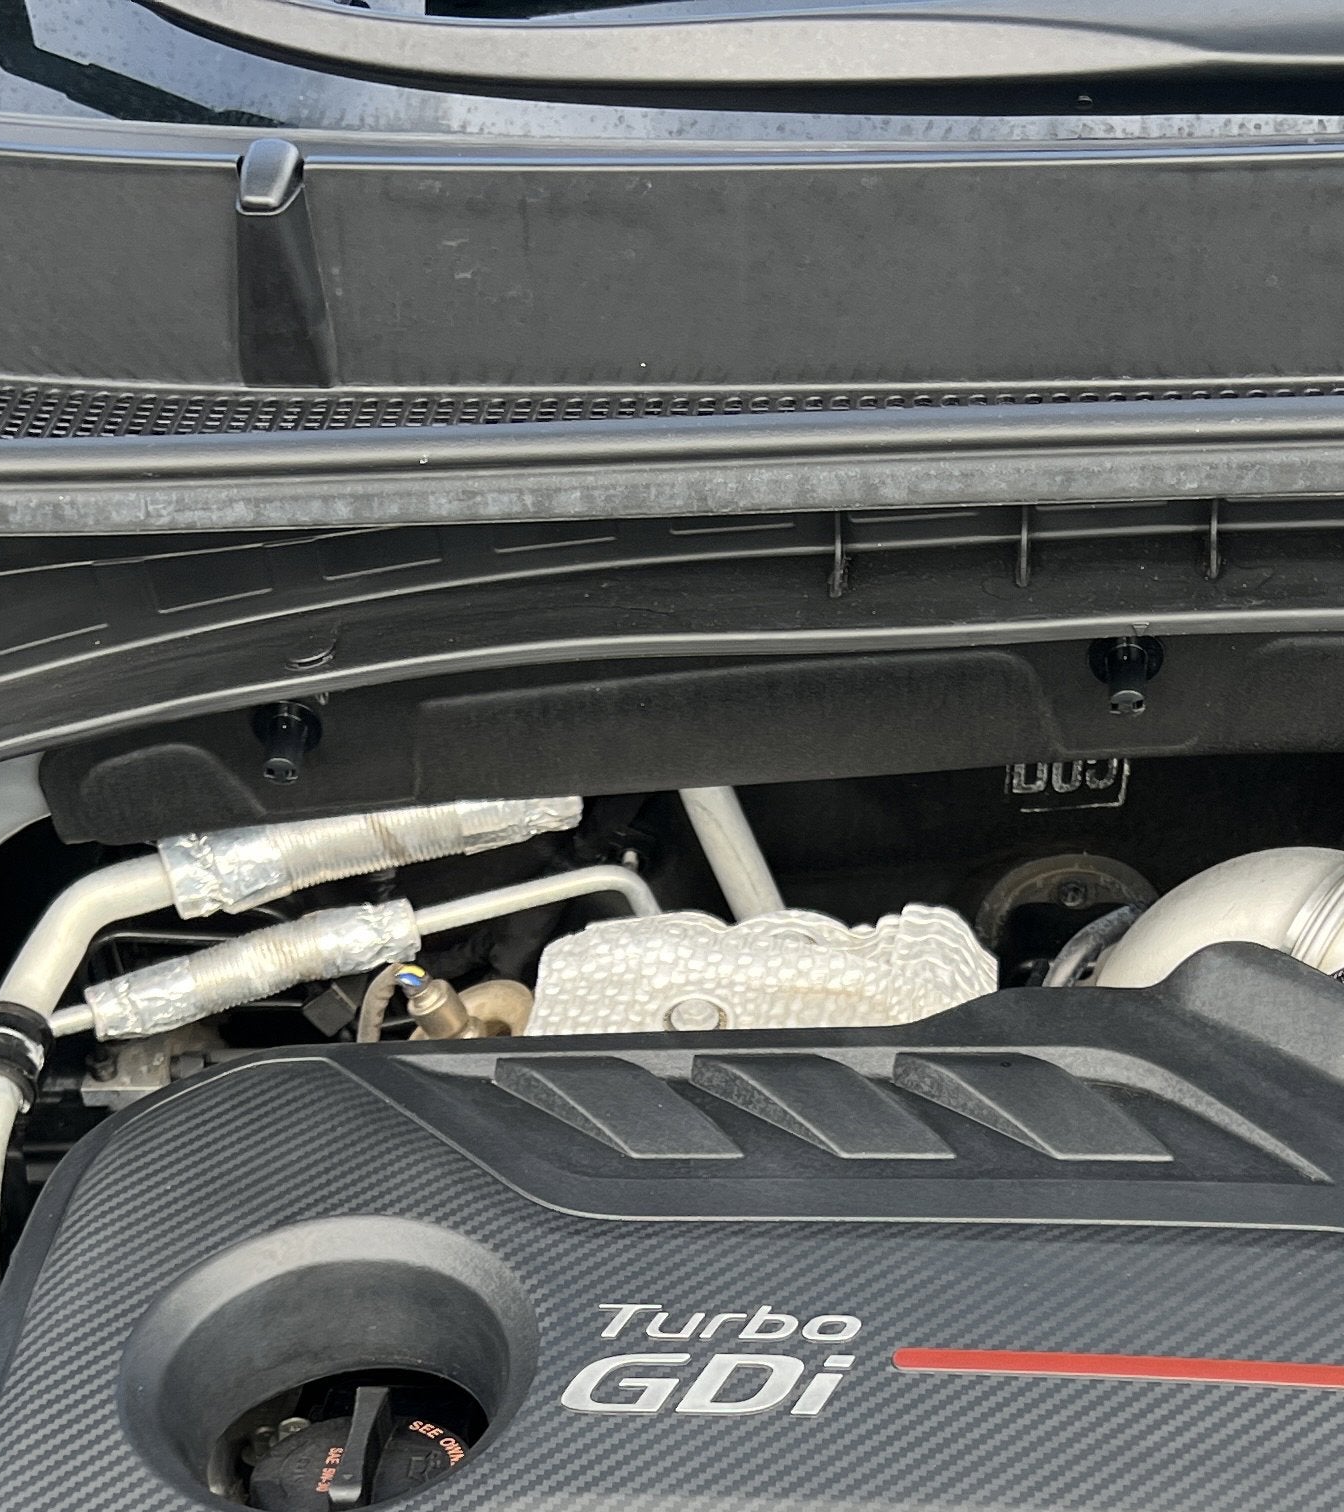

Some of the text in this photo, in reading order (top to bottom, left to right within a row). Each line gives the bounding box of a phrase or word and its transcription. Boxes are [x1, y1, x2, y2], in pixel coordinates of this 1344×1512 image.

[598, 1303, 863, 1342] Turbo
[560, 1353, 856, 1416] GDi
[409, 1420, 443, 1439] SEE
